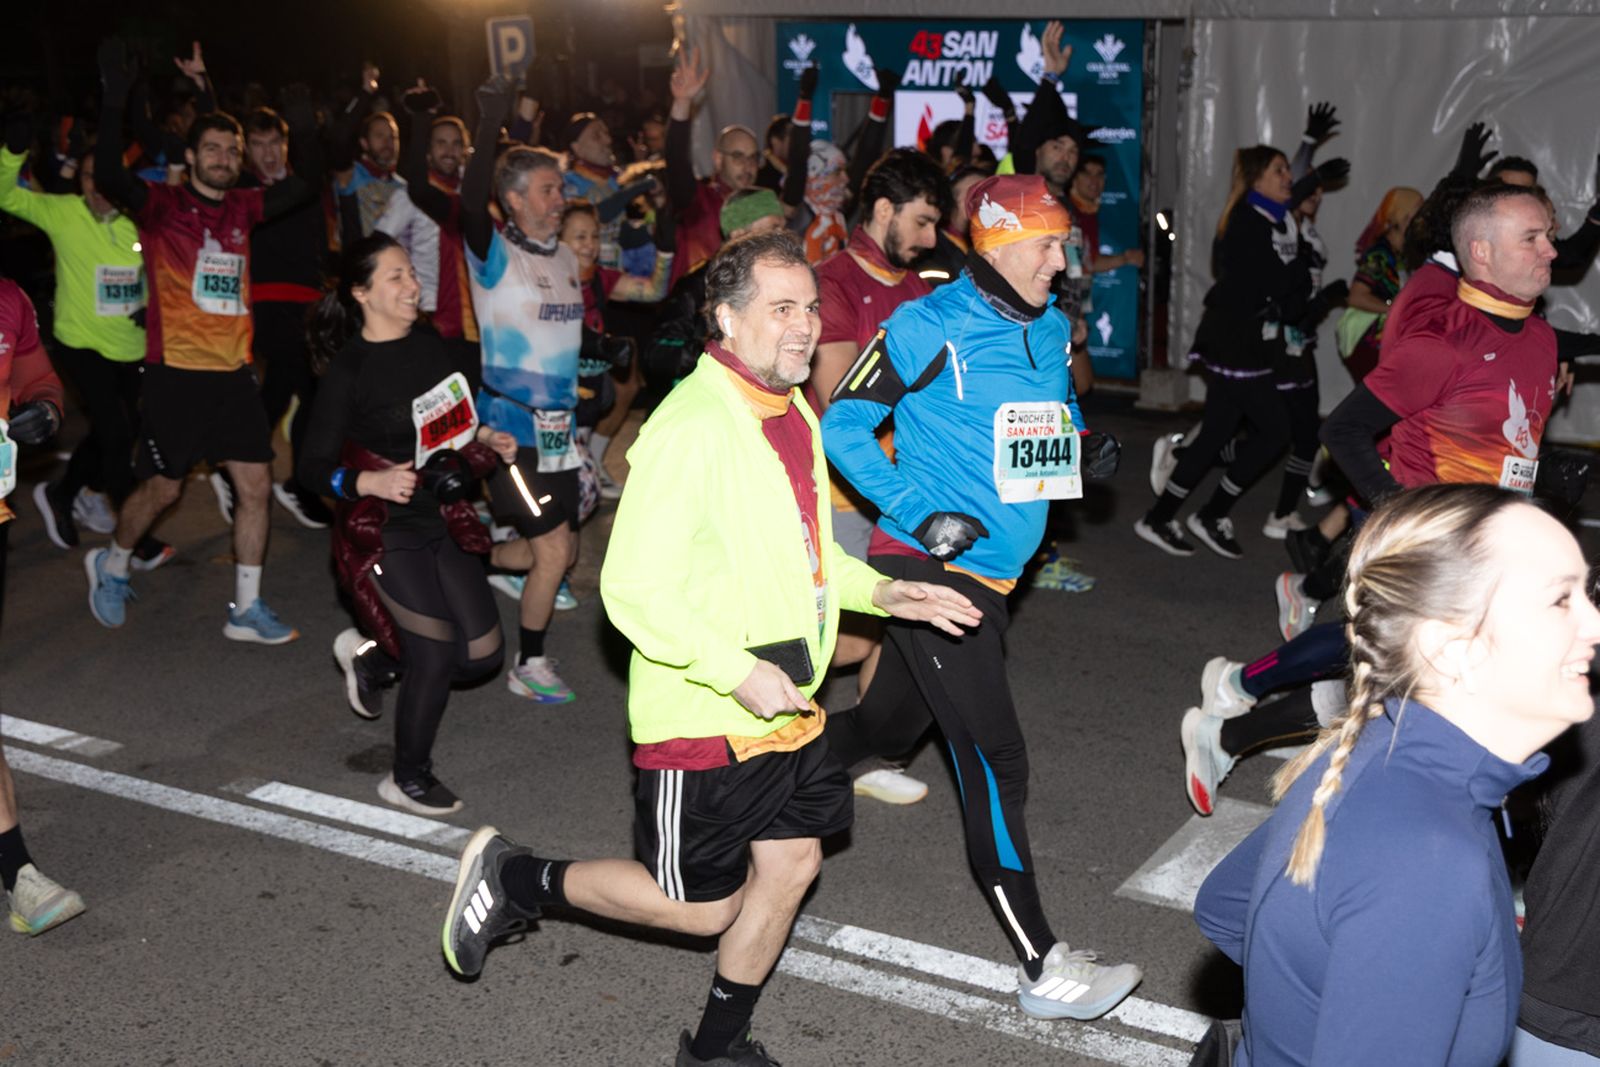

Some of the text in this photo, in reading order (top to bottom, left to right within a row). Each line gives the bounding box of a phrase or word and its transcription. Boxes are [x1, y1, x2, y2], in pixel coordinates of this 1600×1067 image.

[499, 27, 526, 80] P
[908, 30, 943, 60] 43
[900, 53, 993, 87] ANTÓN
[985, 122, 1008, 140] SA
[1007, 427, 1025, 437] SAN
[1018, 413, 1056, 424] NOCHE DE
[1008, 437, 1072, 468] 13444
